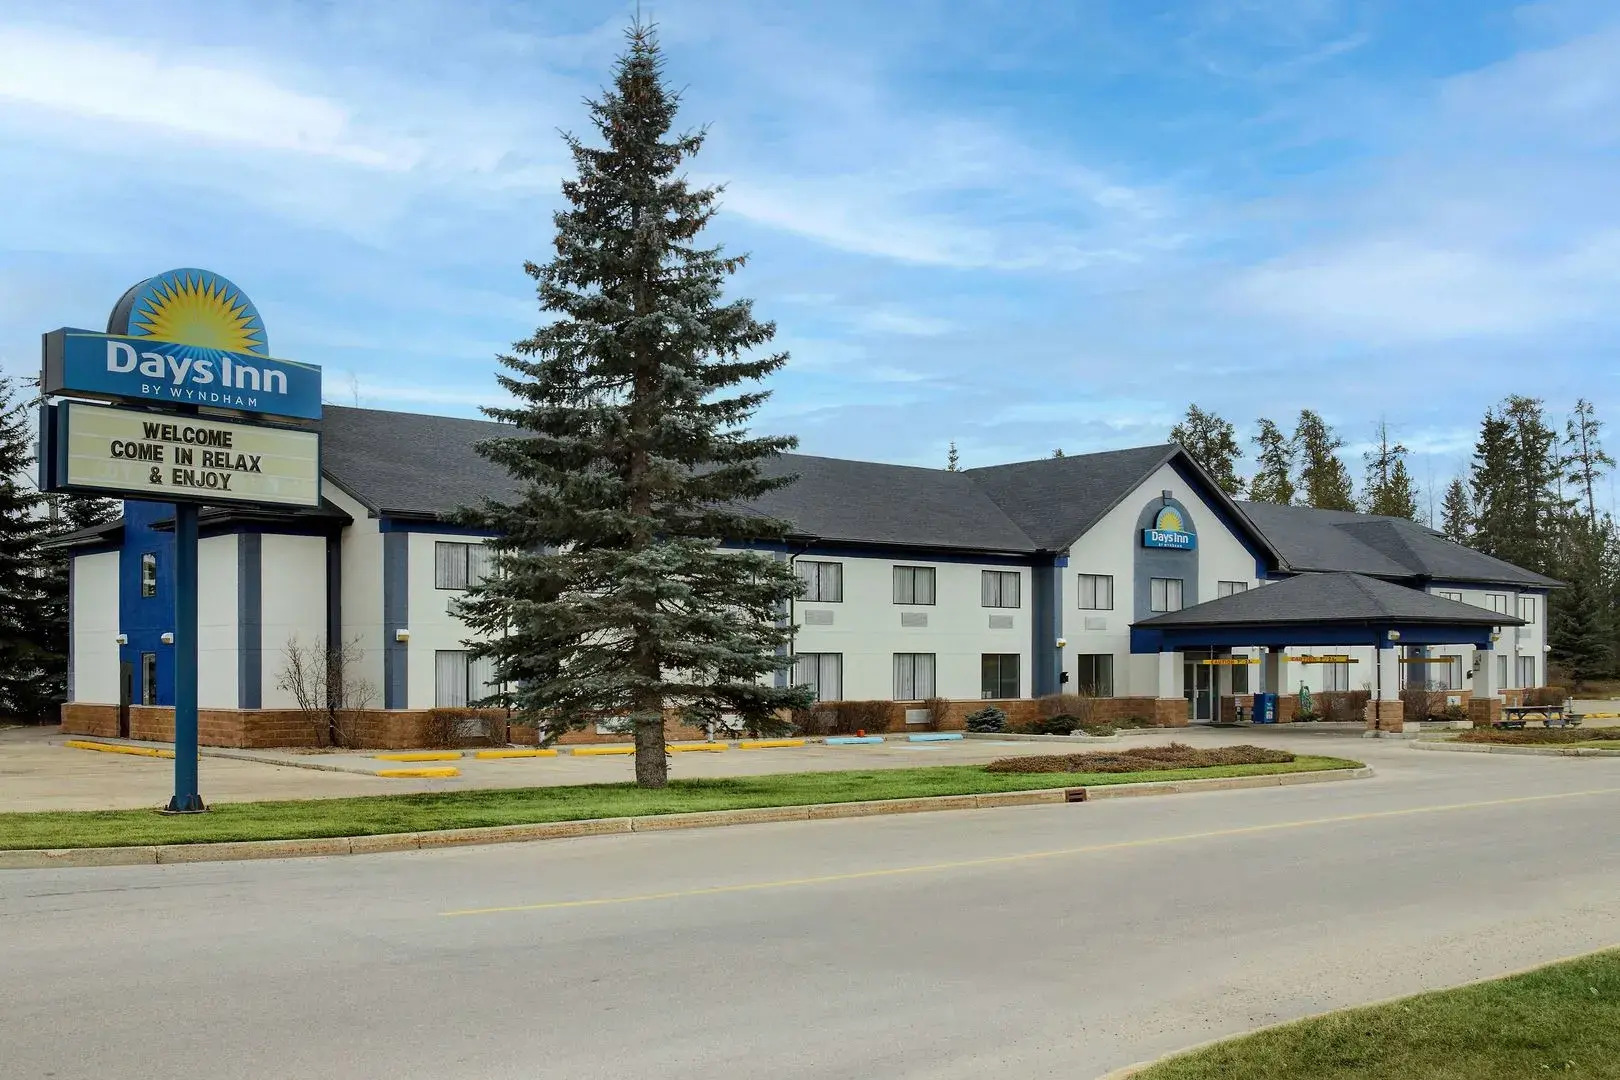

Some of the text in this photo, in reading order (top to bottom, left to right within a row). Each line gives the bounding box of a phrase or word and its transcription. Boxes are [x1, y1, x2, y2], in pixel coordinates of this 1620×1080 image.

[107, 340, 288, 395] Days Inn
[142, 384, 257, 407] BY WYNDHAM
[143, 421, 233, 448] WELCOME
[110, 440, 262, 473] COME IN RELAX
[150, 466, 232, 490] & ENJOY
[1152, 531, 1189, 544] Days Inn
